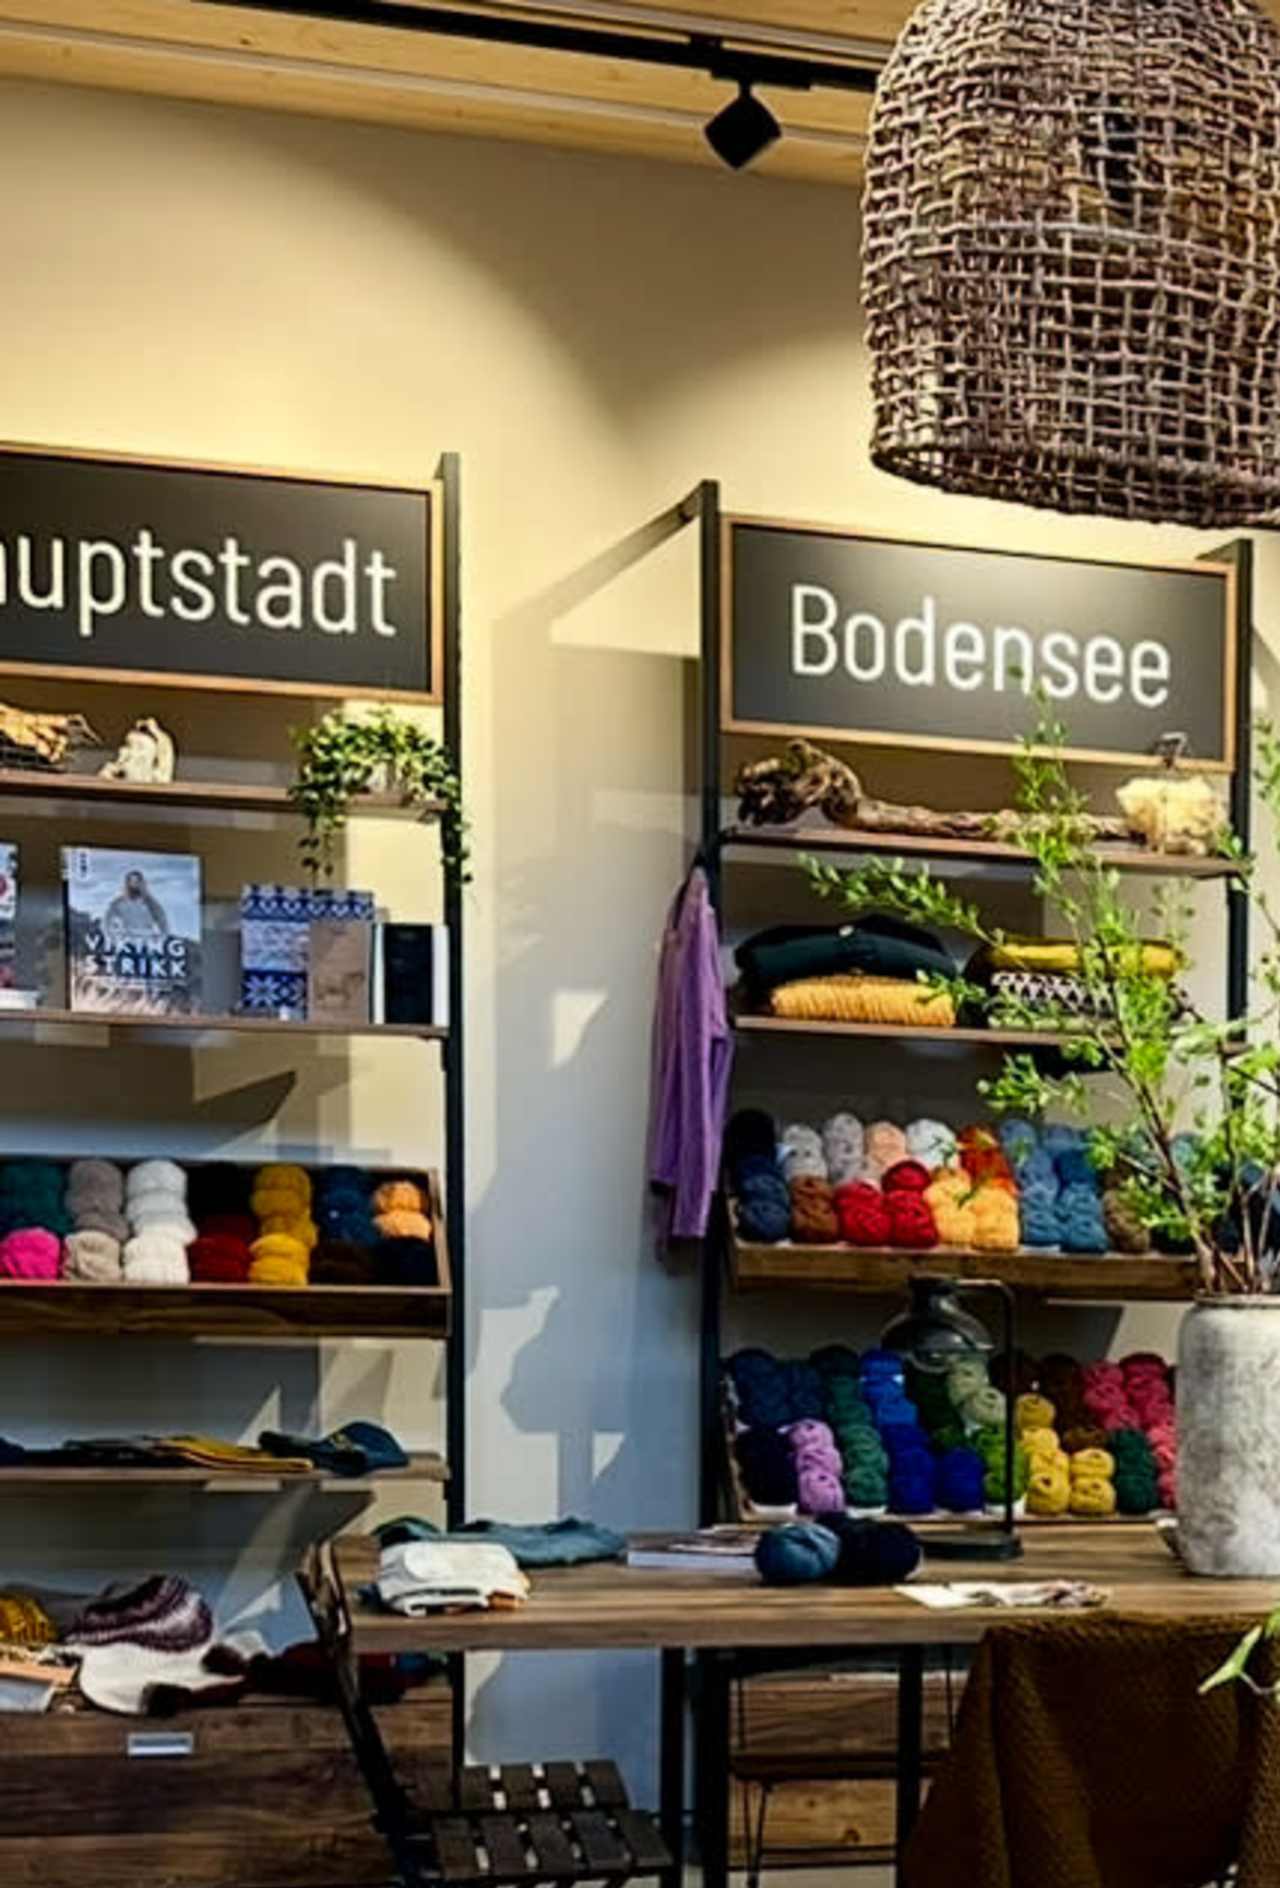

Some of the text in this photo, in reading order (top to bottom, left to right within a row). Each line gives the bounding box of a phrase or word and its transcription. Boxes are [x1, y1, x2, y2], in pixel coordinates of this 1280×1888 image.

[0, 528, 396, 637] uptstadt
[792, 583, 1171, 707] Bodensee
[82, 954, 187, 977] STRIKK
[84, 932, 186, 957] VIKING
